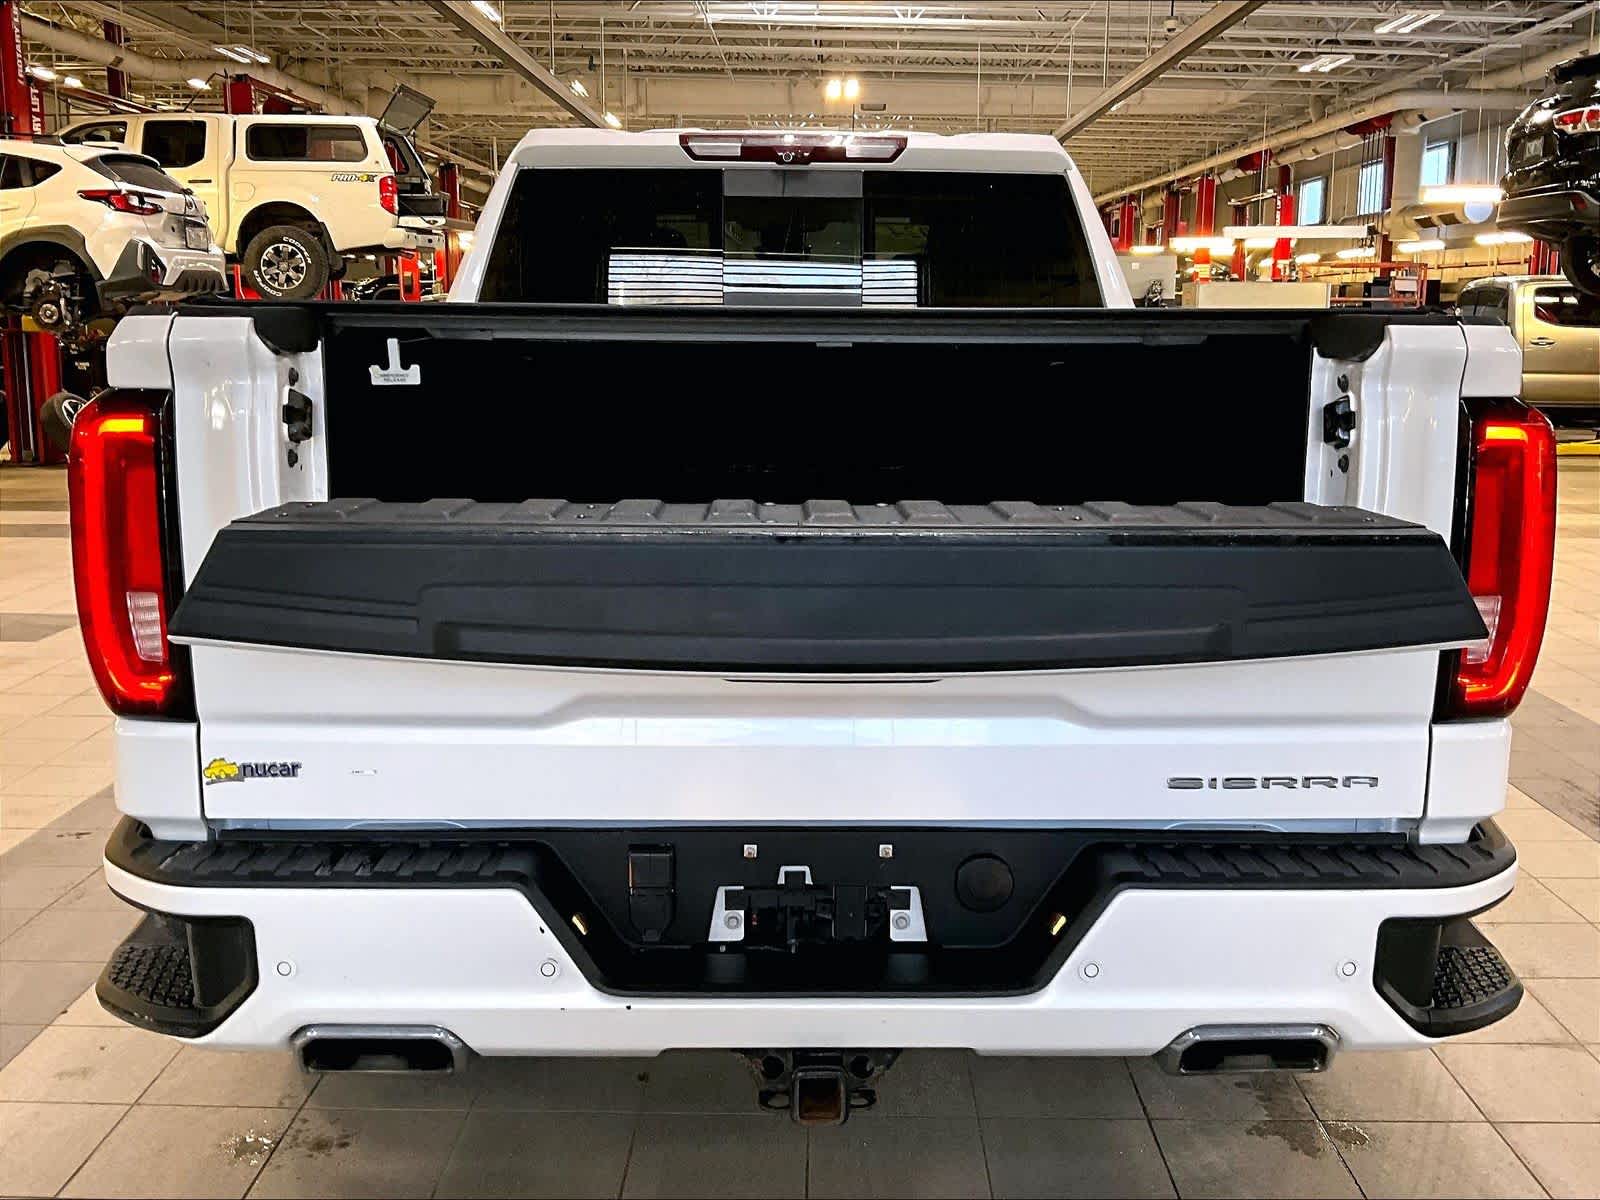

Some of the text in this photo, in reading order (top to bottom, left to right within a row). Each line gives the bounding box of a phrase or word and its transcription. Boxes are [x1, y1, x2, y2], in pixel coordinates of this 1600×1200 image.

[30, 86, 40, 113] LIFT
[242, 762, 302, 778] nucar
[1166, 776, 1379, 790] SIERRA
